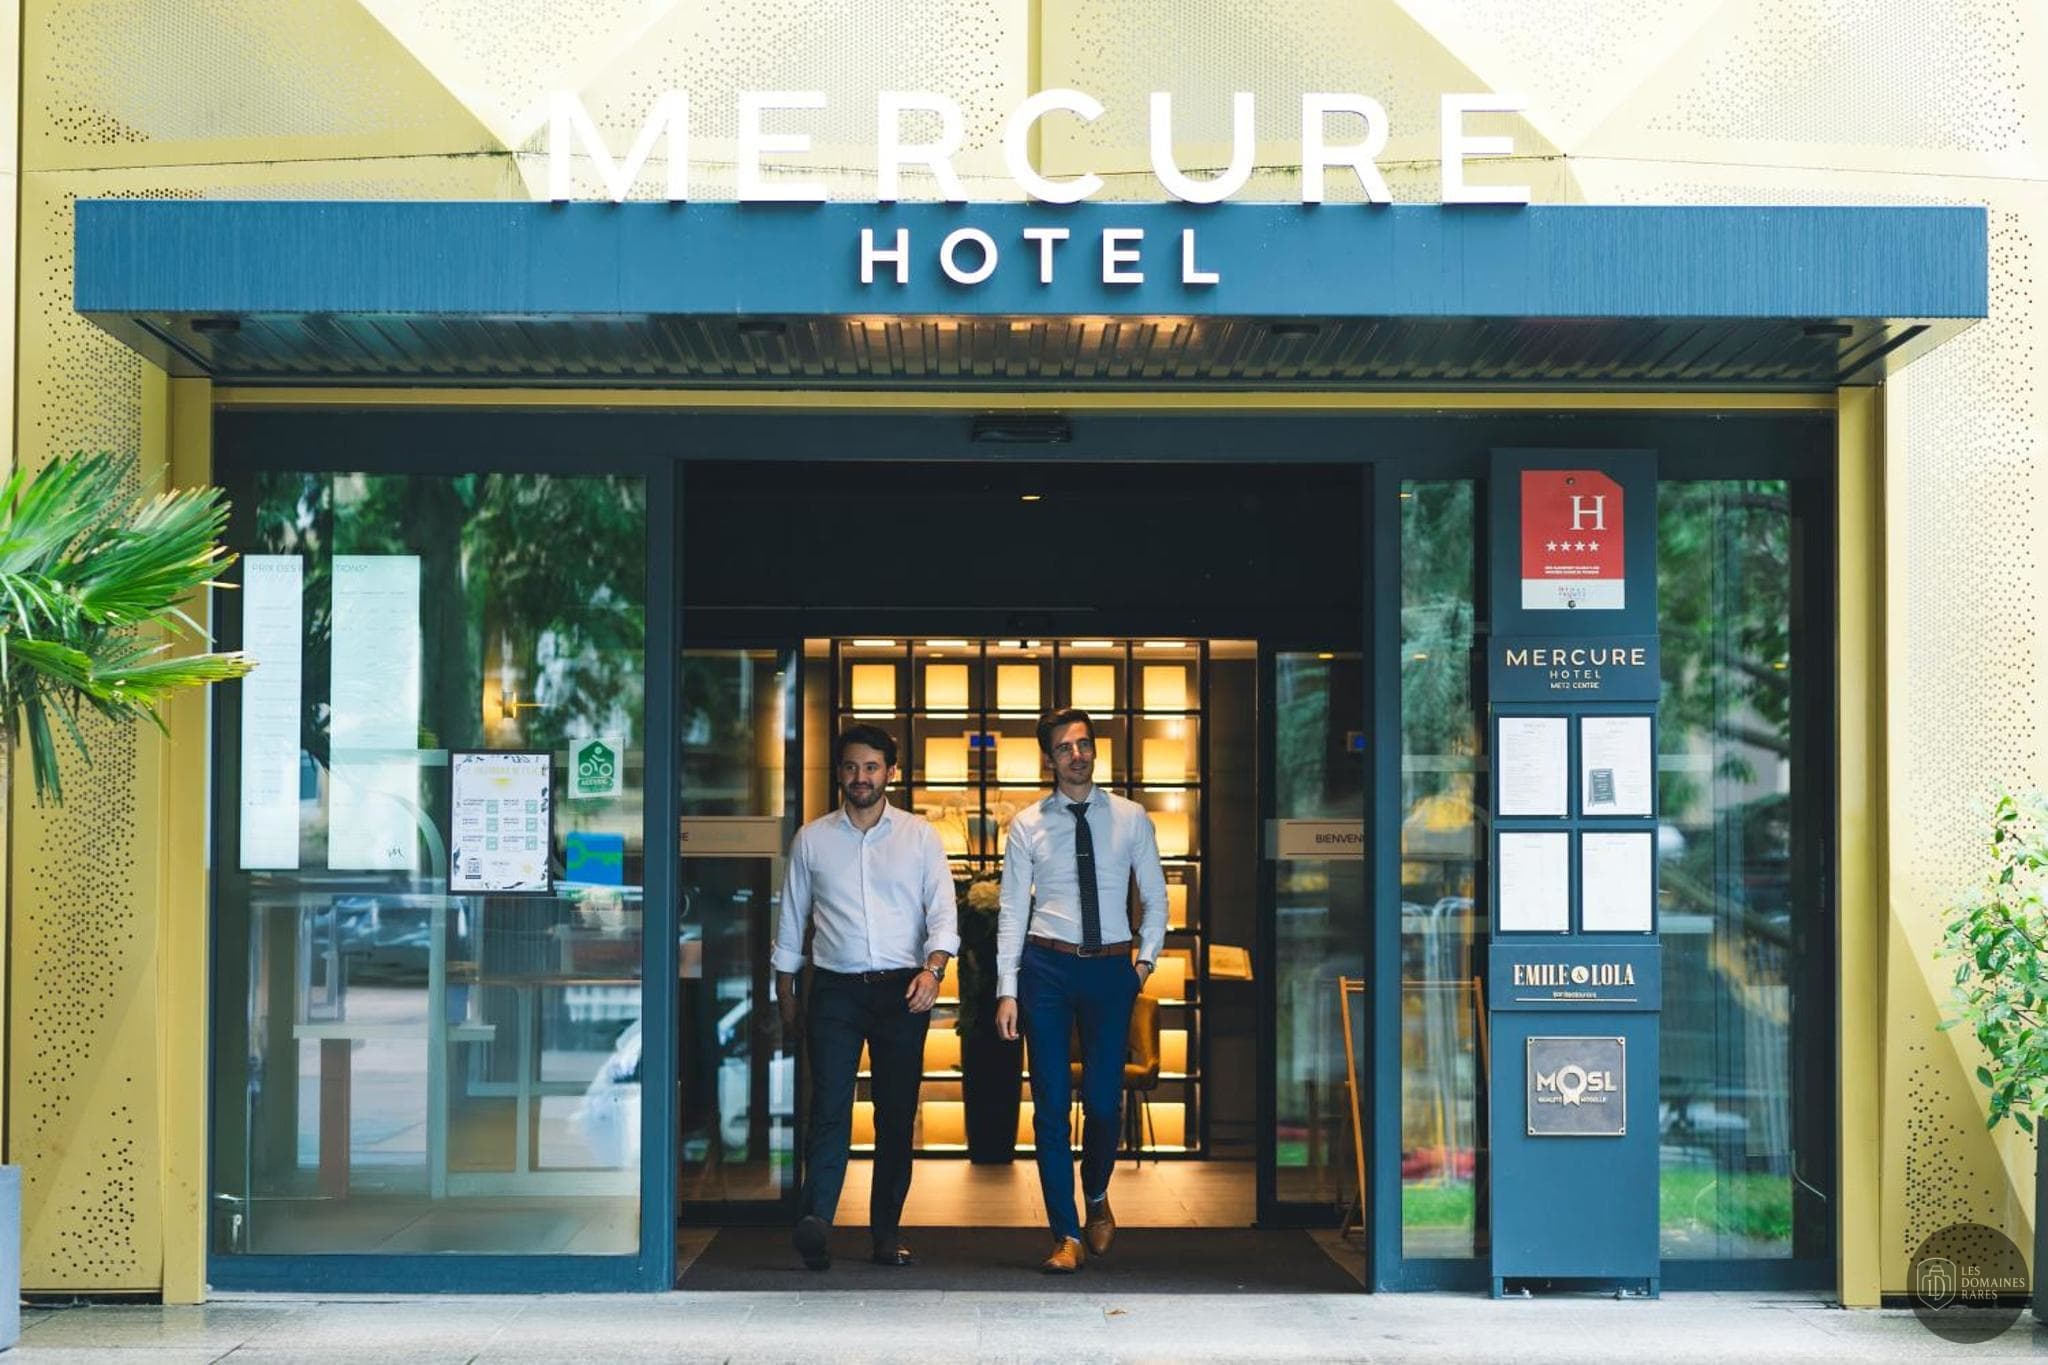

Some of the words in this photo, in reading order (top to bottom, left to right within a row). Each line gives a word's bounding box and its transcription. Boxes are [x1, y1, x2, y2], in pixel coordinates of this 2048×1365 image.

[547, 89, 1530, 205] MERCURE
[860, 228, 1219, 286] HOTEL
[1569, 495, 1607, 530] H
[1506, 649, 1645, 666] MERCURE
[1550, 670, 1601, 679] HOTEL
[1513, 964, 1570, 986] EMILE
[1591, 963, 1636, 986] LOLA
[1536, 1065, 1617, 1094] MOSL
